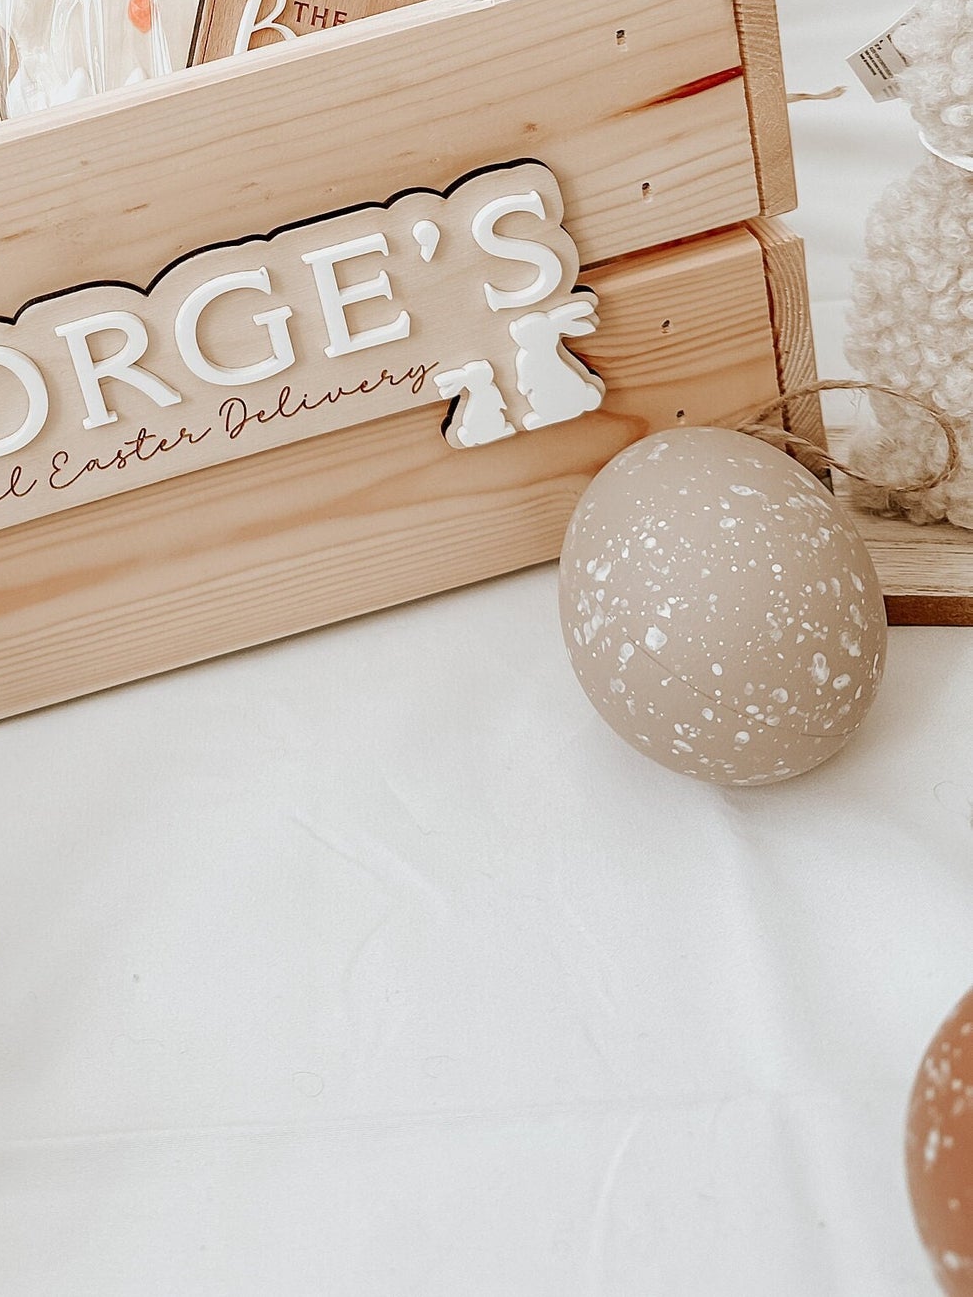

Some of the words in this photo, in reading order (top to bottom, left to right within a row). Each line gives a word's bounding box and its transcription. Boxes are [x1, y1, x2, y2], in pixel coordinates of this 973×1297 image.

[293, 0, 348, 29] THE
[49, 427, 211, 490] Easter
[219, 360, 440, 438] Delivery
